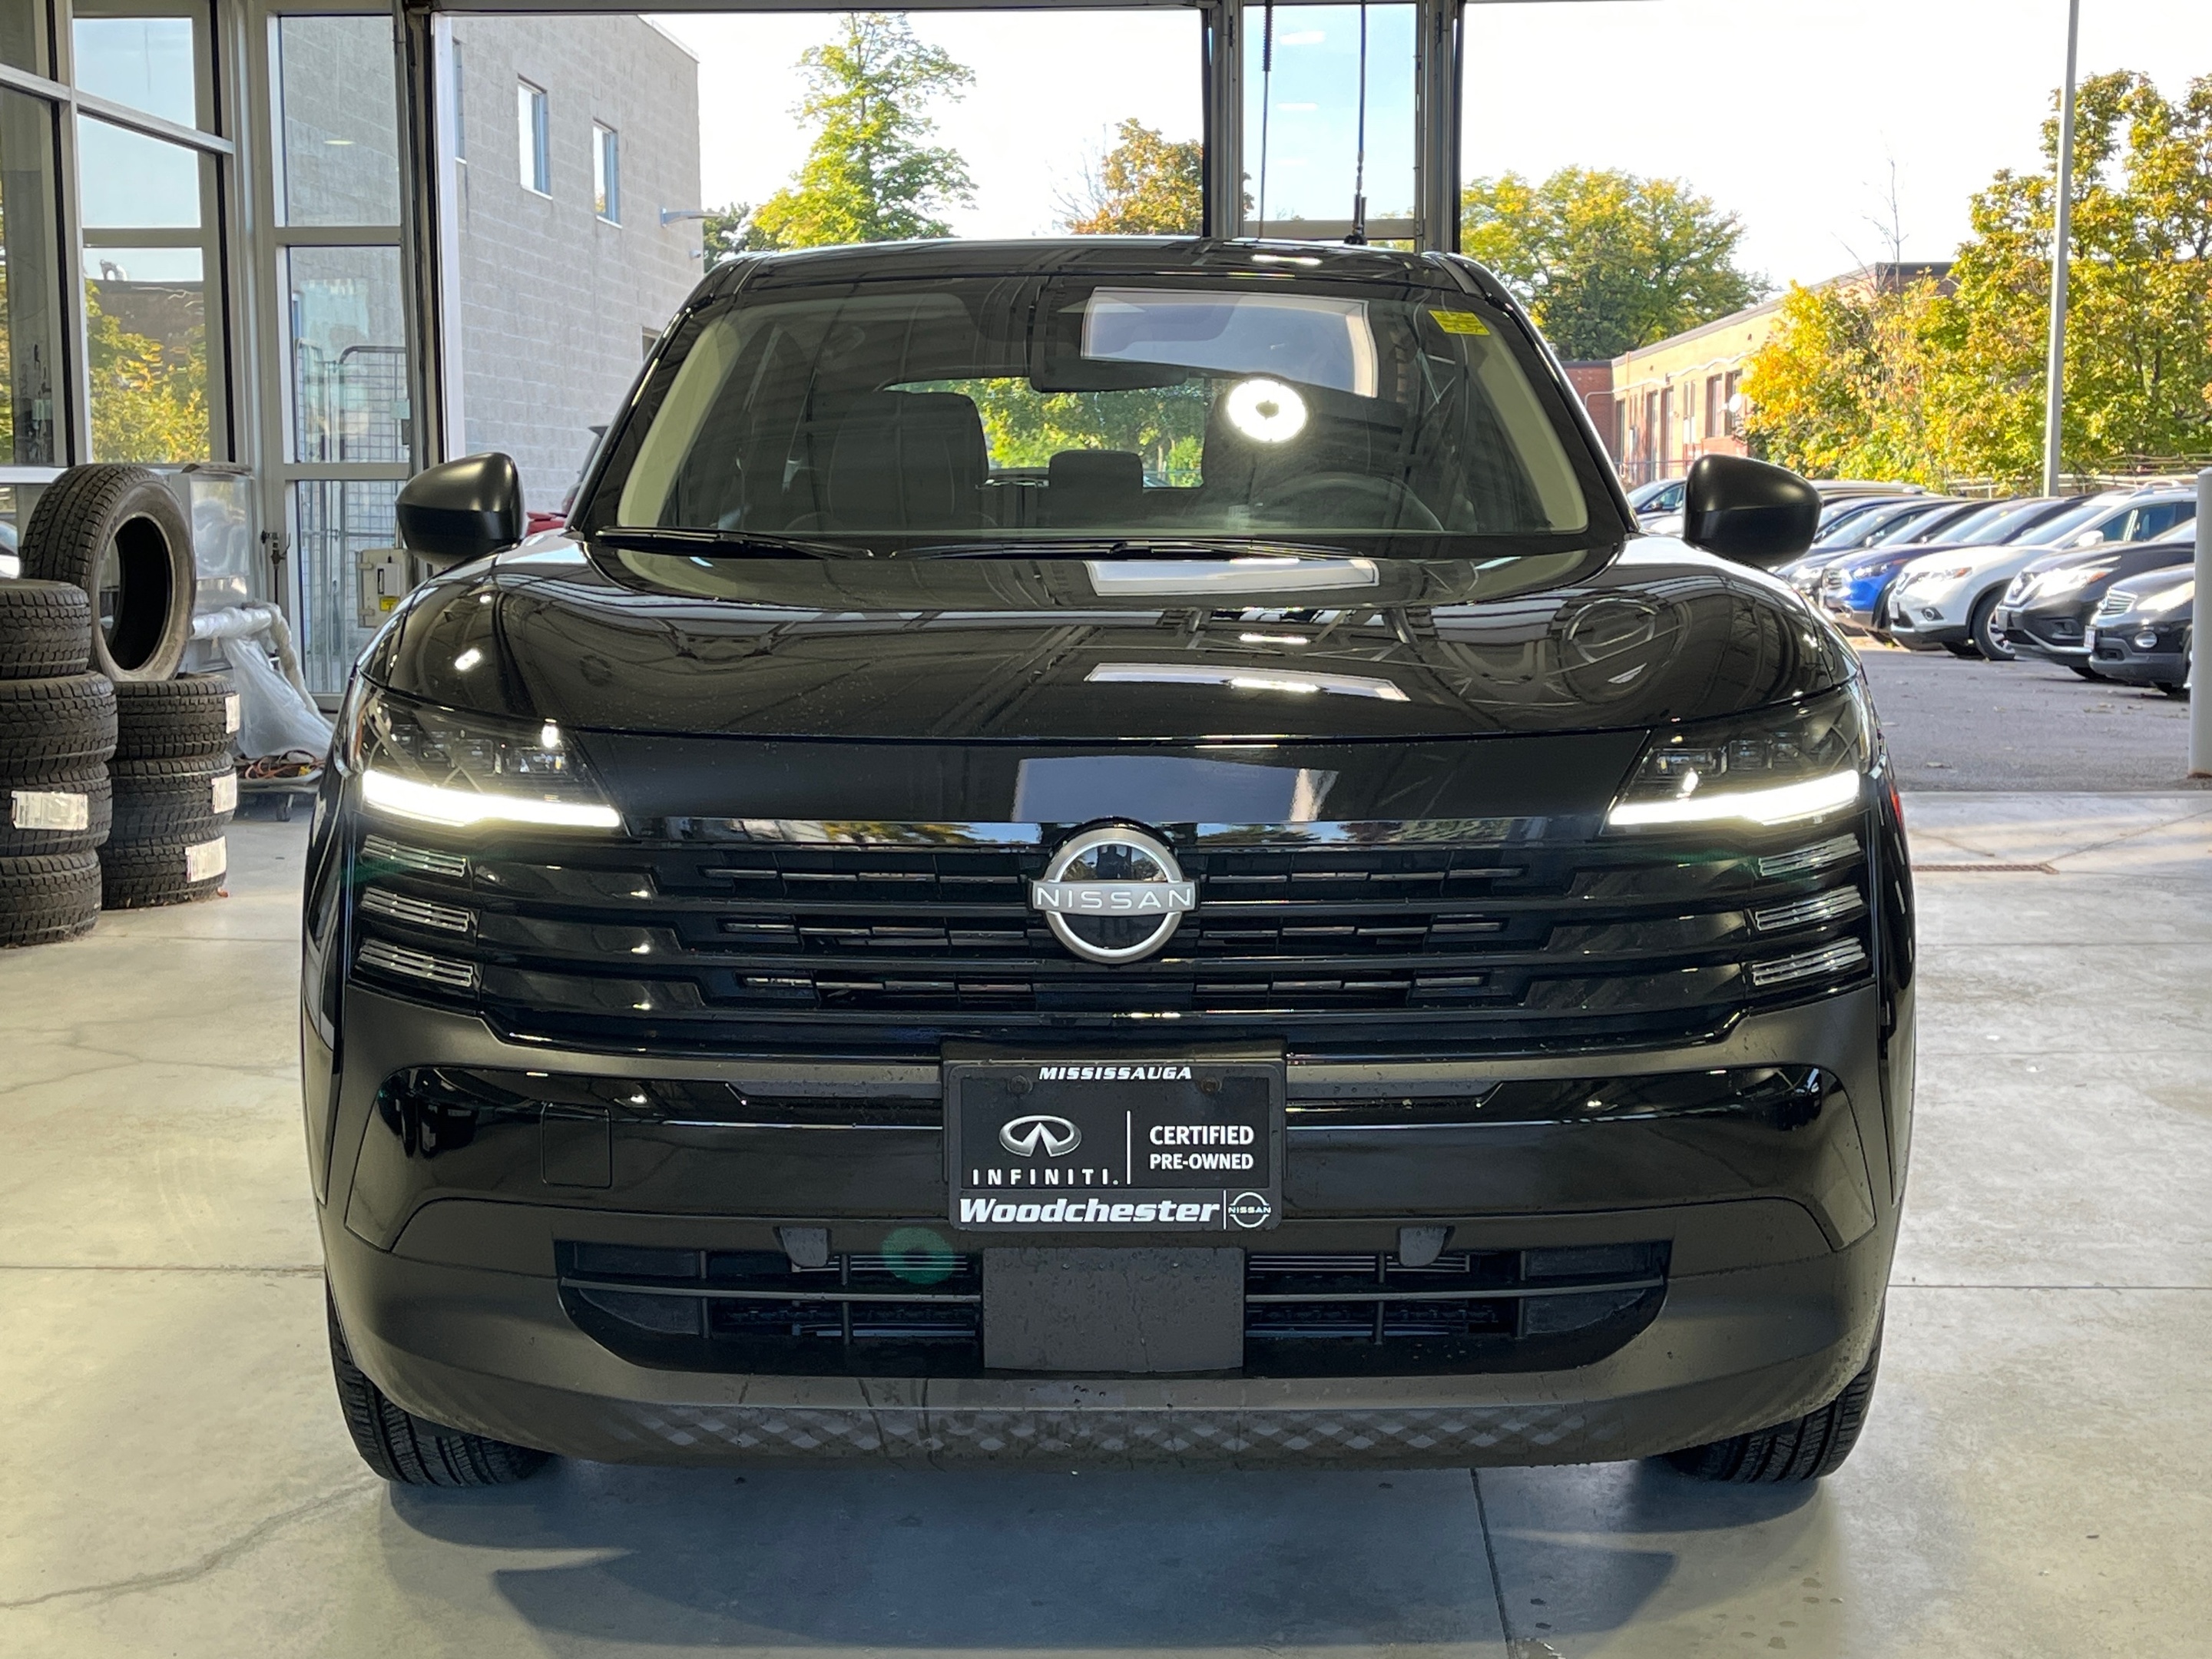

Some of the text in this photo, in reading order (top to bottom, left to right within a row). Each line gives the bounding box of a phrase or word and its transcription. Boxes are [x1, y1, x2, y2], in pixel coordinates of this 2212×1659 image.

[1038, 888, 1190, 909] NISSAN
[1039, 1067, 1192, 1080] MISSISSAUGA
[1150, 1126, 1254, 1145] CERTIFIED
[1151, 1154, 1253, 1170] PRE-OWNED
[960, 1197, 1220, 1223] Woodchester
